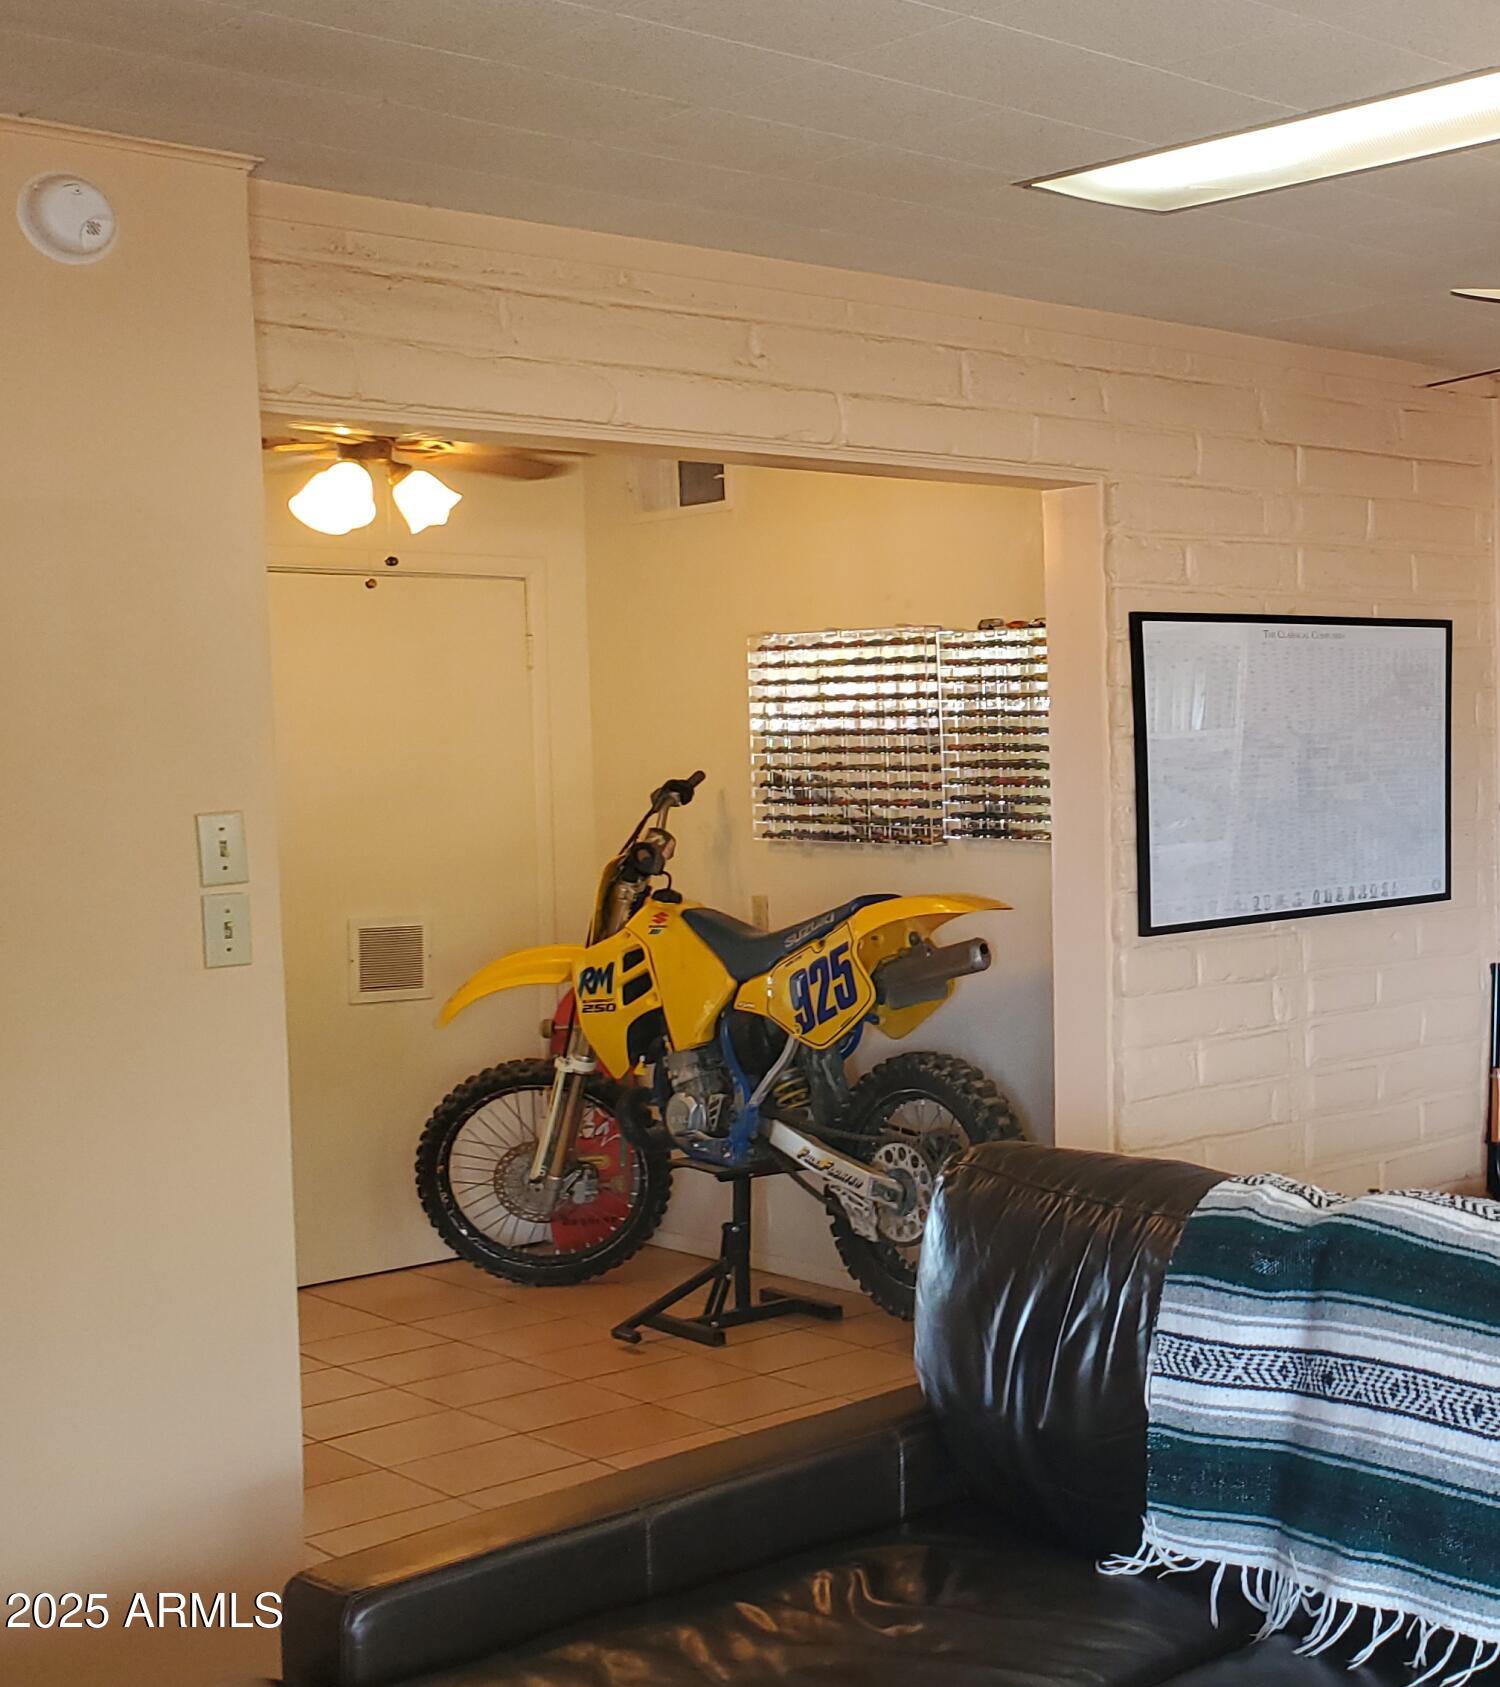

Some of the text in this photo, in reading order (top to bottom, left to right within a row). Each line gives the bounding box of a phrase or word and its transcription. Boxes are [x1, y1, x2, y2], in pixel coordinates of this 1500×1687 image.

[784, 912, 835, 948] SUZUKI
[578, 961, 615, 999] RM
[789, 941, 858, 1035] 925
[582, 1003, 616, 1013] 250
